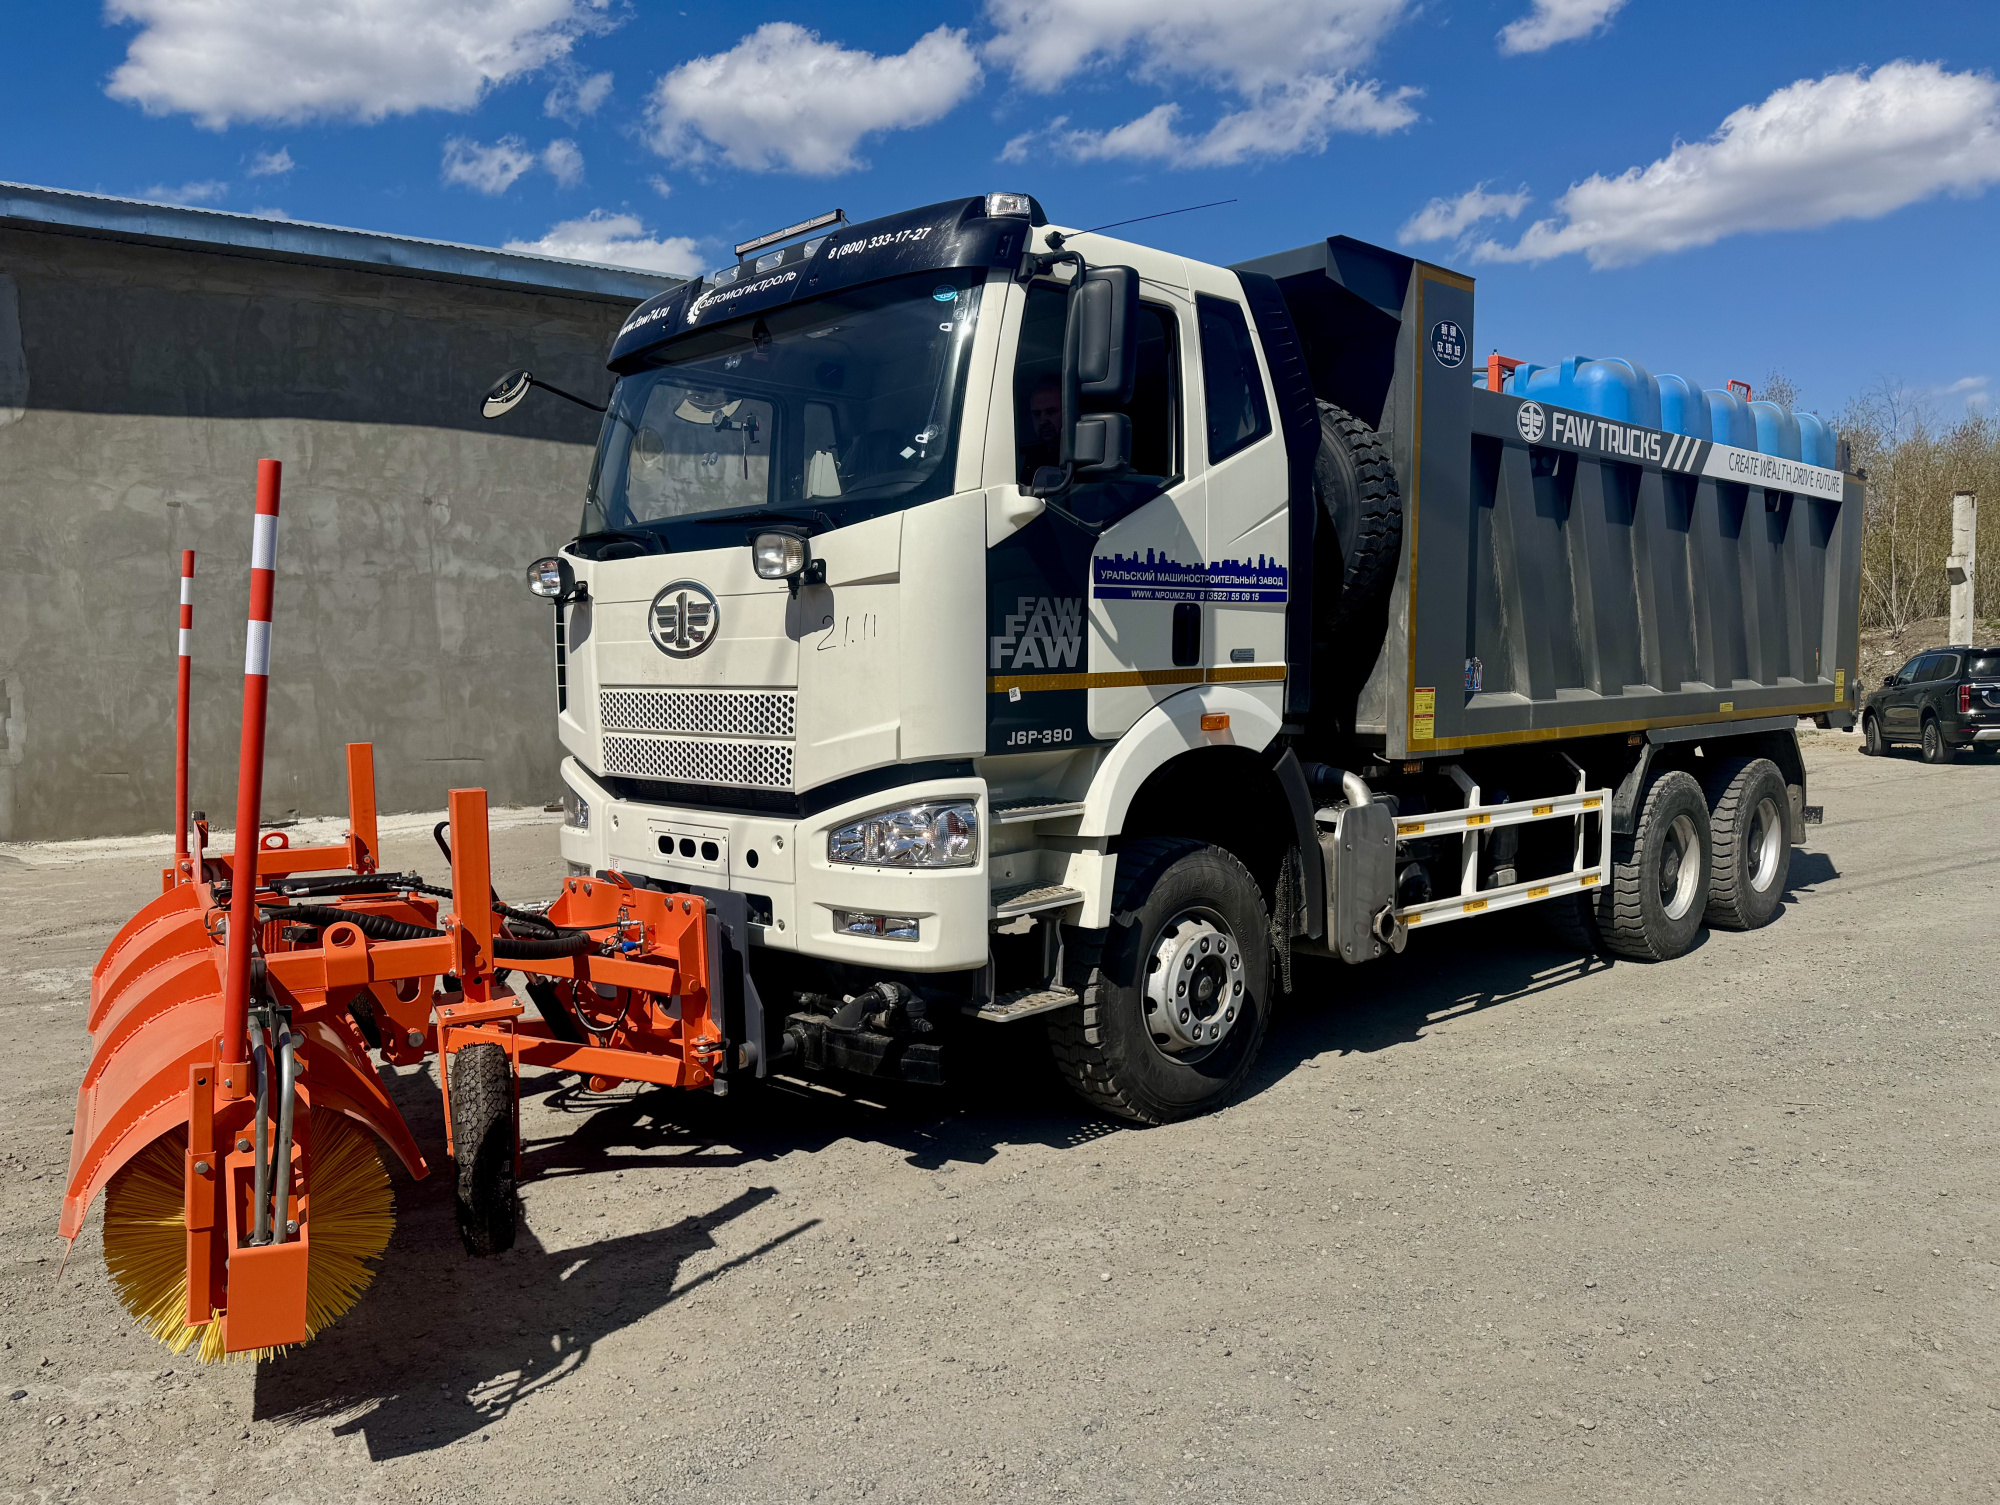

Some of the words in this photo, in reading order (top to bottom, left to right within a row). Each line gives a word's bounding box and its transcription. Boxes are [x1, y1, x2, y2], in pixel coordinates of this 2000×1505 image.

[827, 247, 837, 260] 8
[837, 238, 867, 260] (800)
[868, 227, 932, 249] 333-17-27
[1552, 411, 1595, 448] FAW
[1597, 421, 1662, 461] TRUCKS
[1728, 452, 1760, 476] CREATE
[1815, 472, 1840, 494] FUTURE
[1100, 569, 1155, 581] УРАЛЬСКИЙ
[1157, 572, 1257, 585] МАШИНОСТРОИТЕЛЬНЫЙ
[1258, 576, 1284, 587] ЗАВОД
[1017, 596, 1082, 621] FAW
[1199, 591, 1205, 600] 8
[1206, 592, 1229, 601] (3522)
[1231, 592, 1240, 601] 55
[1241, 592, 1250, 601] 09
[1252, 592, 1260, 601] 15
[1005, 614, 1082, 643] FAW
[990, 636, 1082, 669] FAW
[1006, 728, 1073, 746] J6P-390
